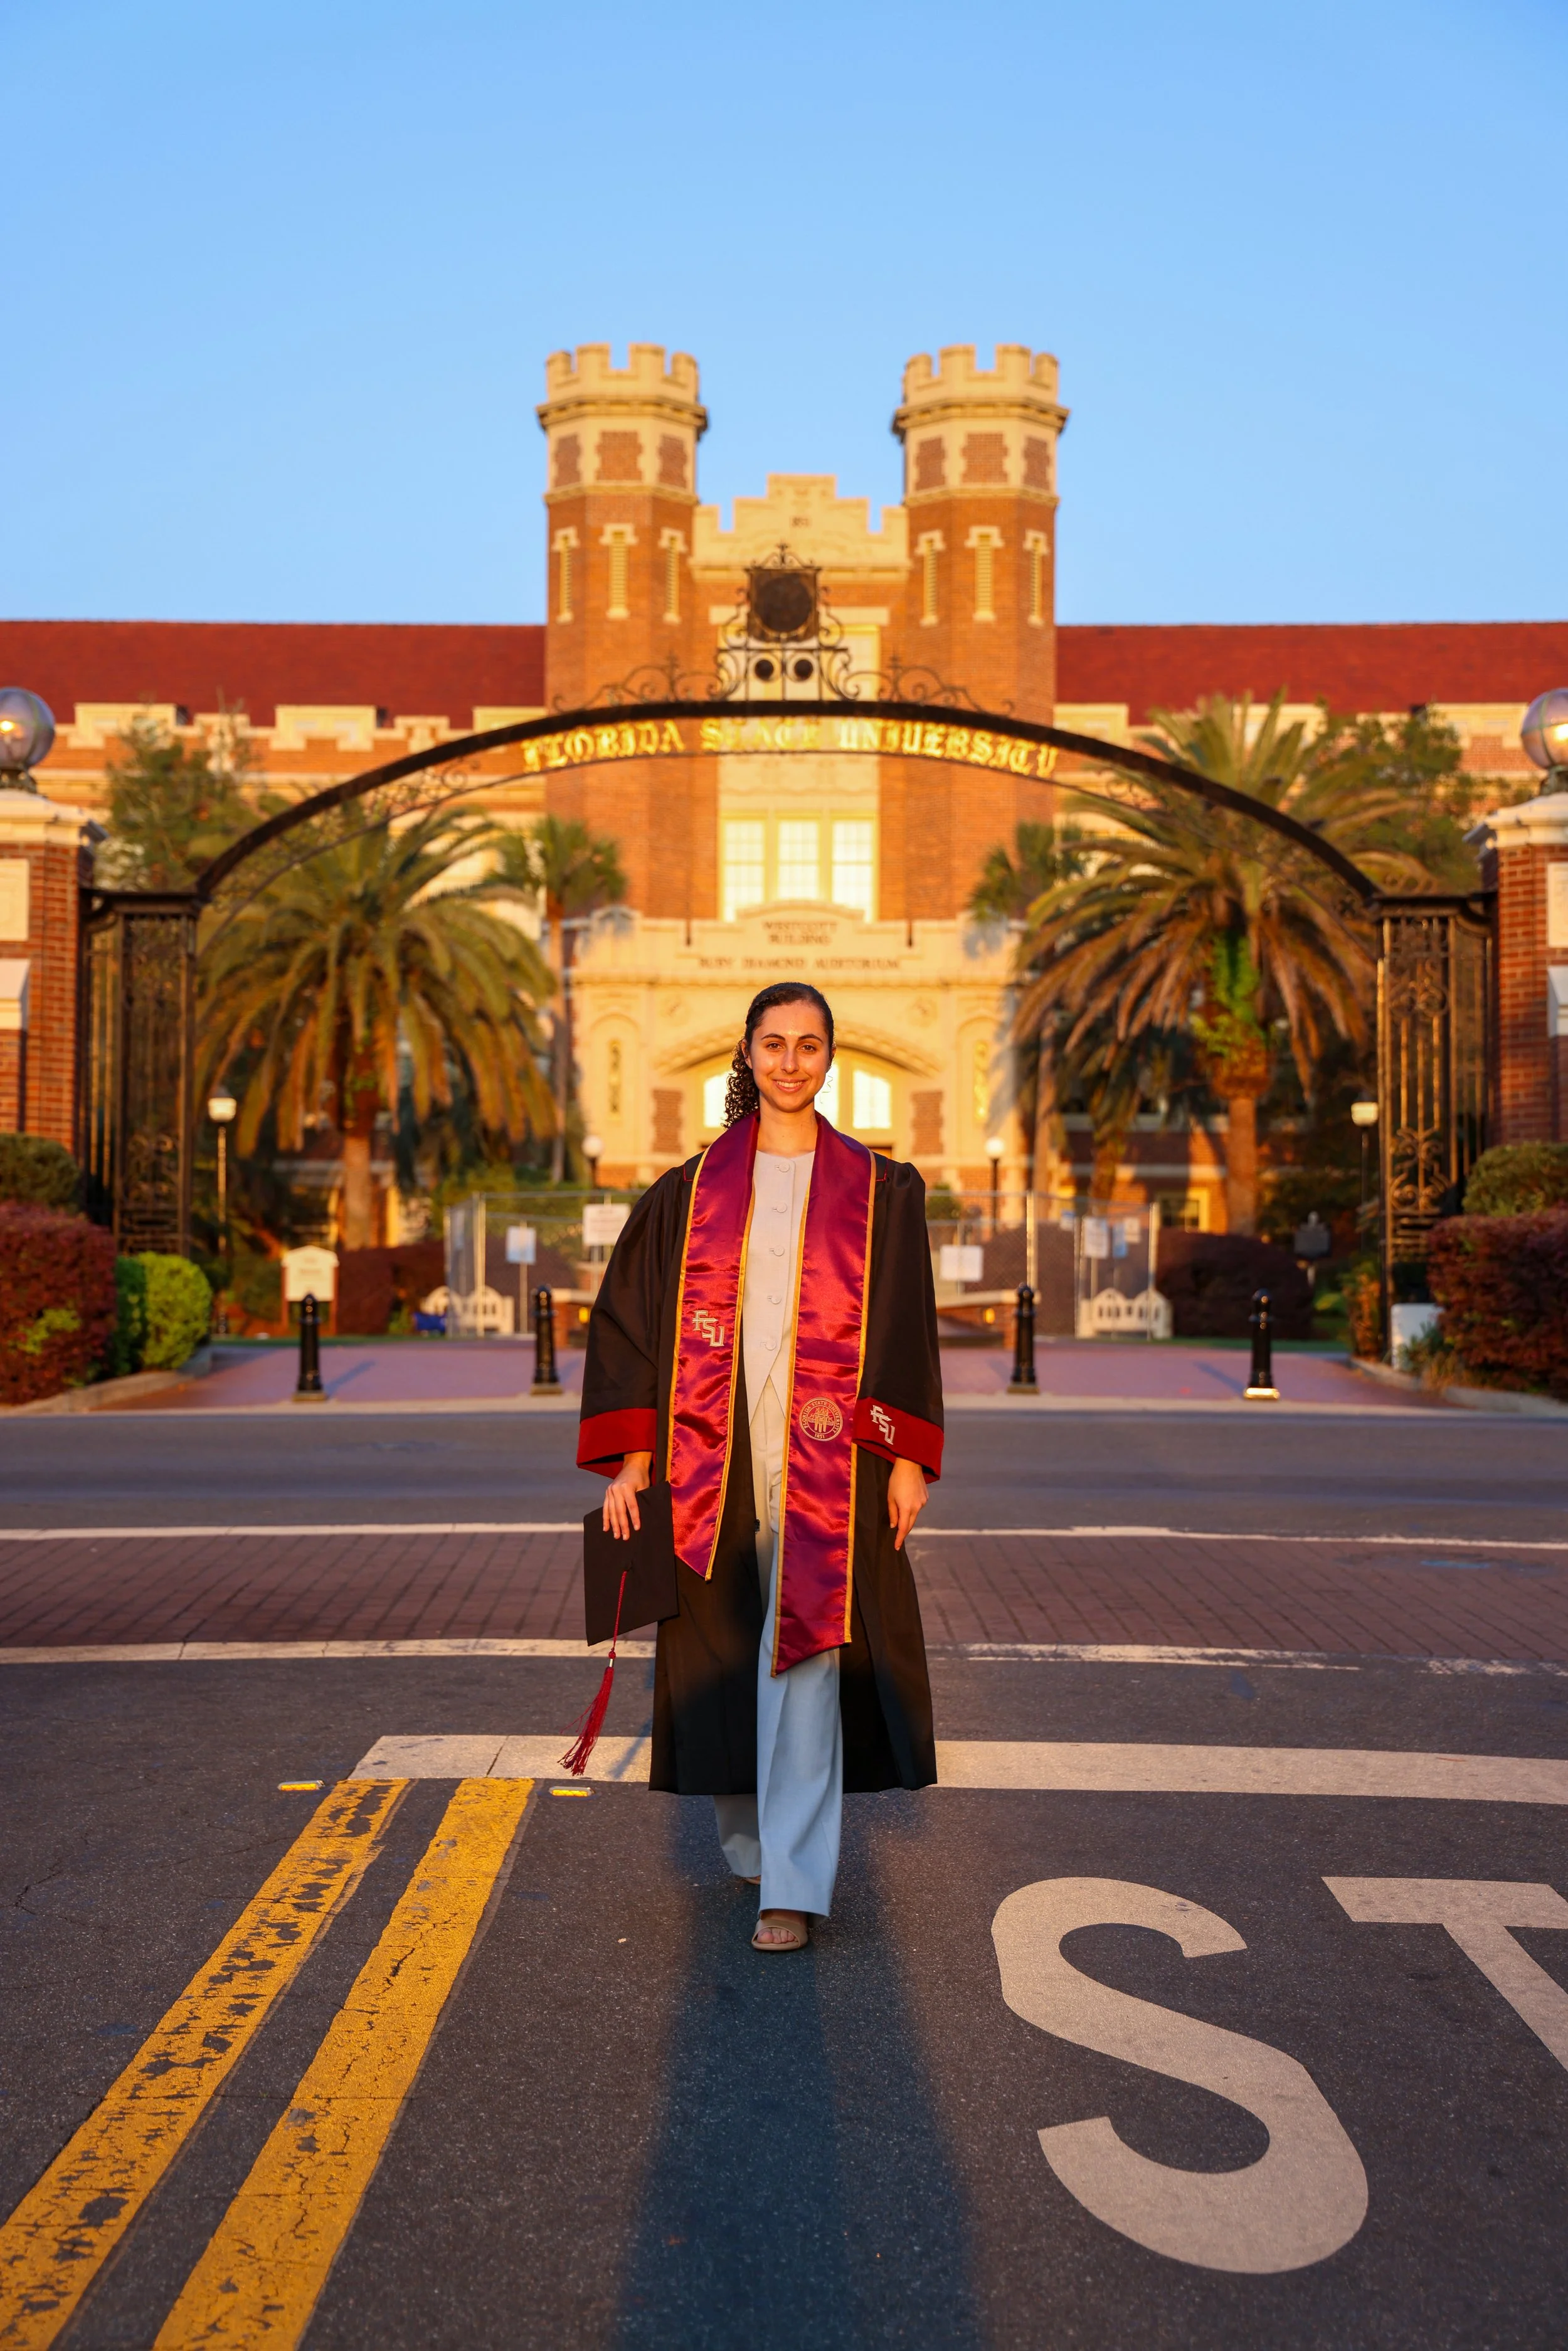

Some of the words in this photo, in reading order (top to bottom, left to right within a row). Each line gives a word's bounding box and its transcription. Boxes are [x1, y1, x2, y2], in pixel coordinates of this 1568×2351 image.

[520, 719, 686, 773] FLORIDA
[699, 717, 821, 750] STATE
[839, 718, 1059, 778] UNIVERSITY
[692, 1310, 725, 1347] FSU
[802, 1406, 812, 1429] FLORIDA
[828, 1403, 840, 1434] UNIVERSITY
[871, 1404, 896, 1445] FSU
